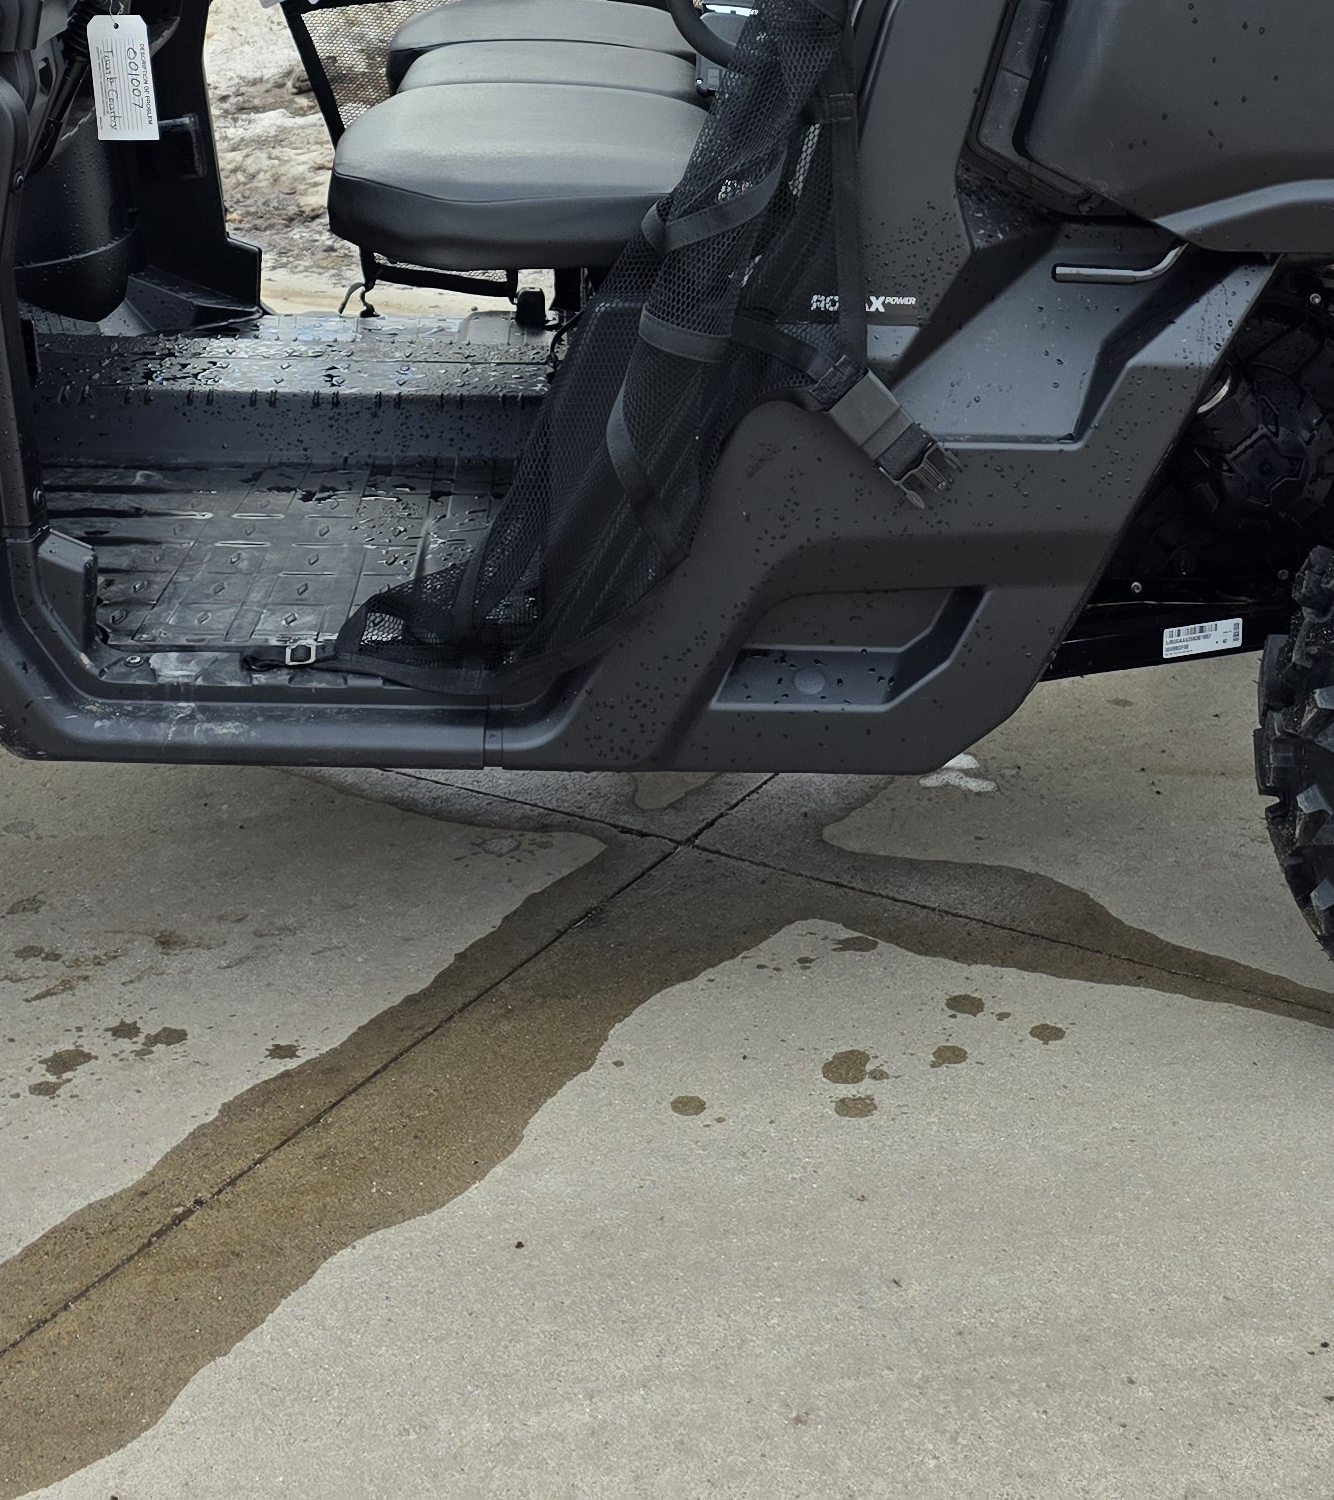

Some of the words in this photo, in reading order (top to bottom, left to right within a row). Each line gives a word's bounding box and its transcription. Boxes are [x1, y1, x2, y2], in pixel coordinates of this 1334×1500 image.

[127, 47, 144, 109] 001007
[139, 43, 149, 85] DESCRIPTION
[143, 85, 150, 95] OF
[144, 95, 154, 125] PROBLEM
[810, 294, 886, 313] ROX
[884, 296, 917, 306] POWER
